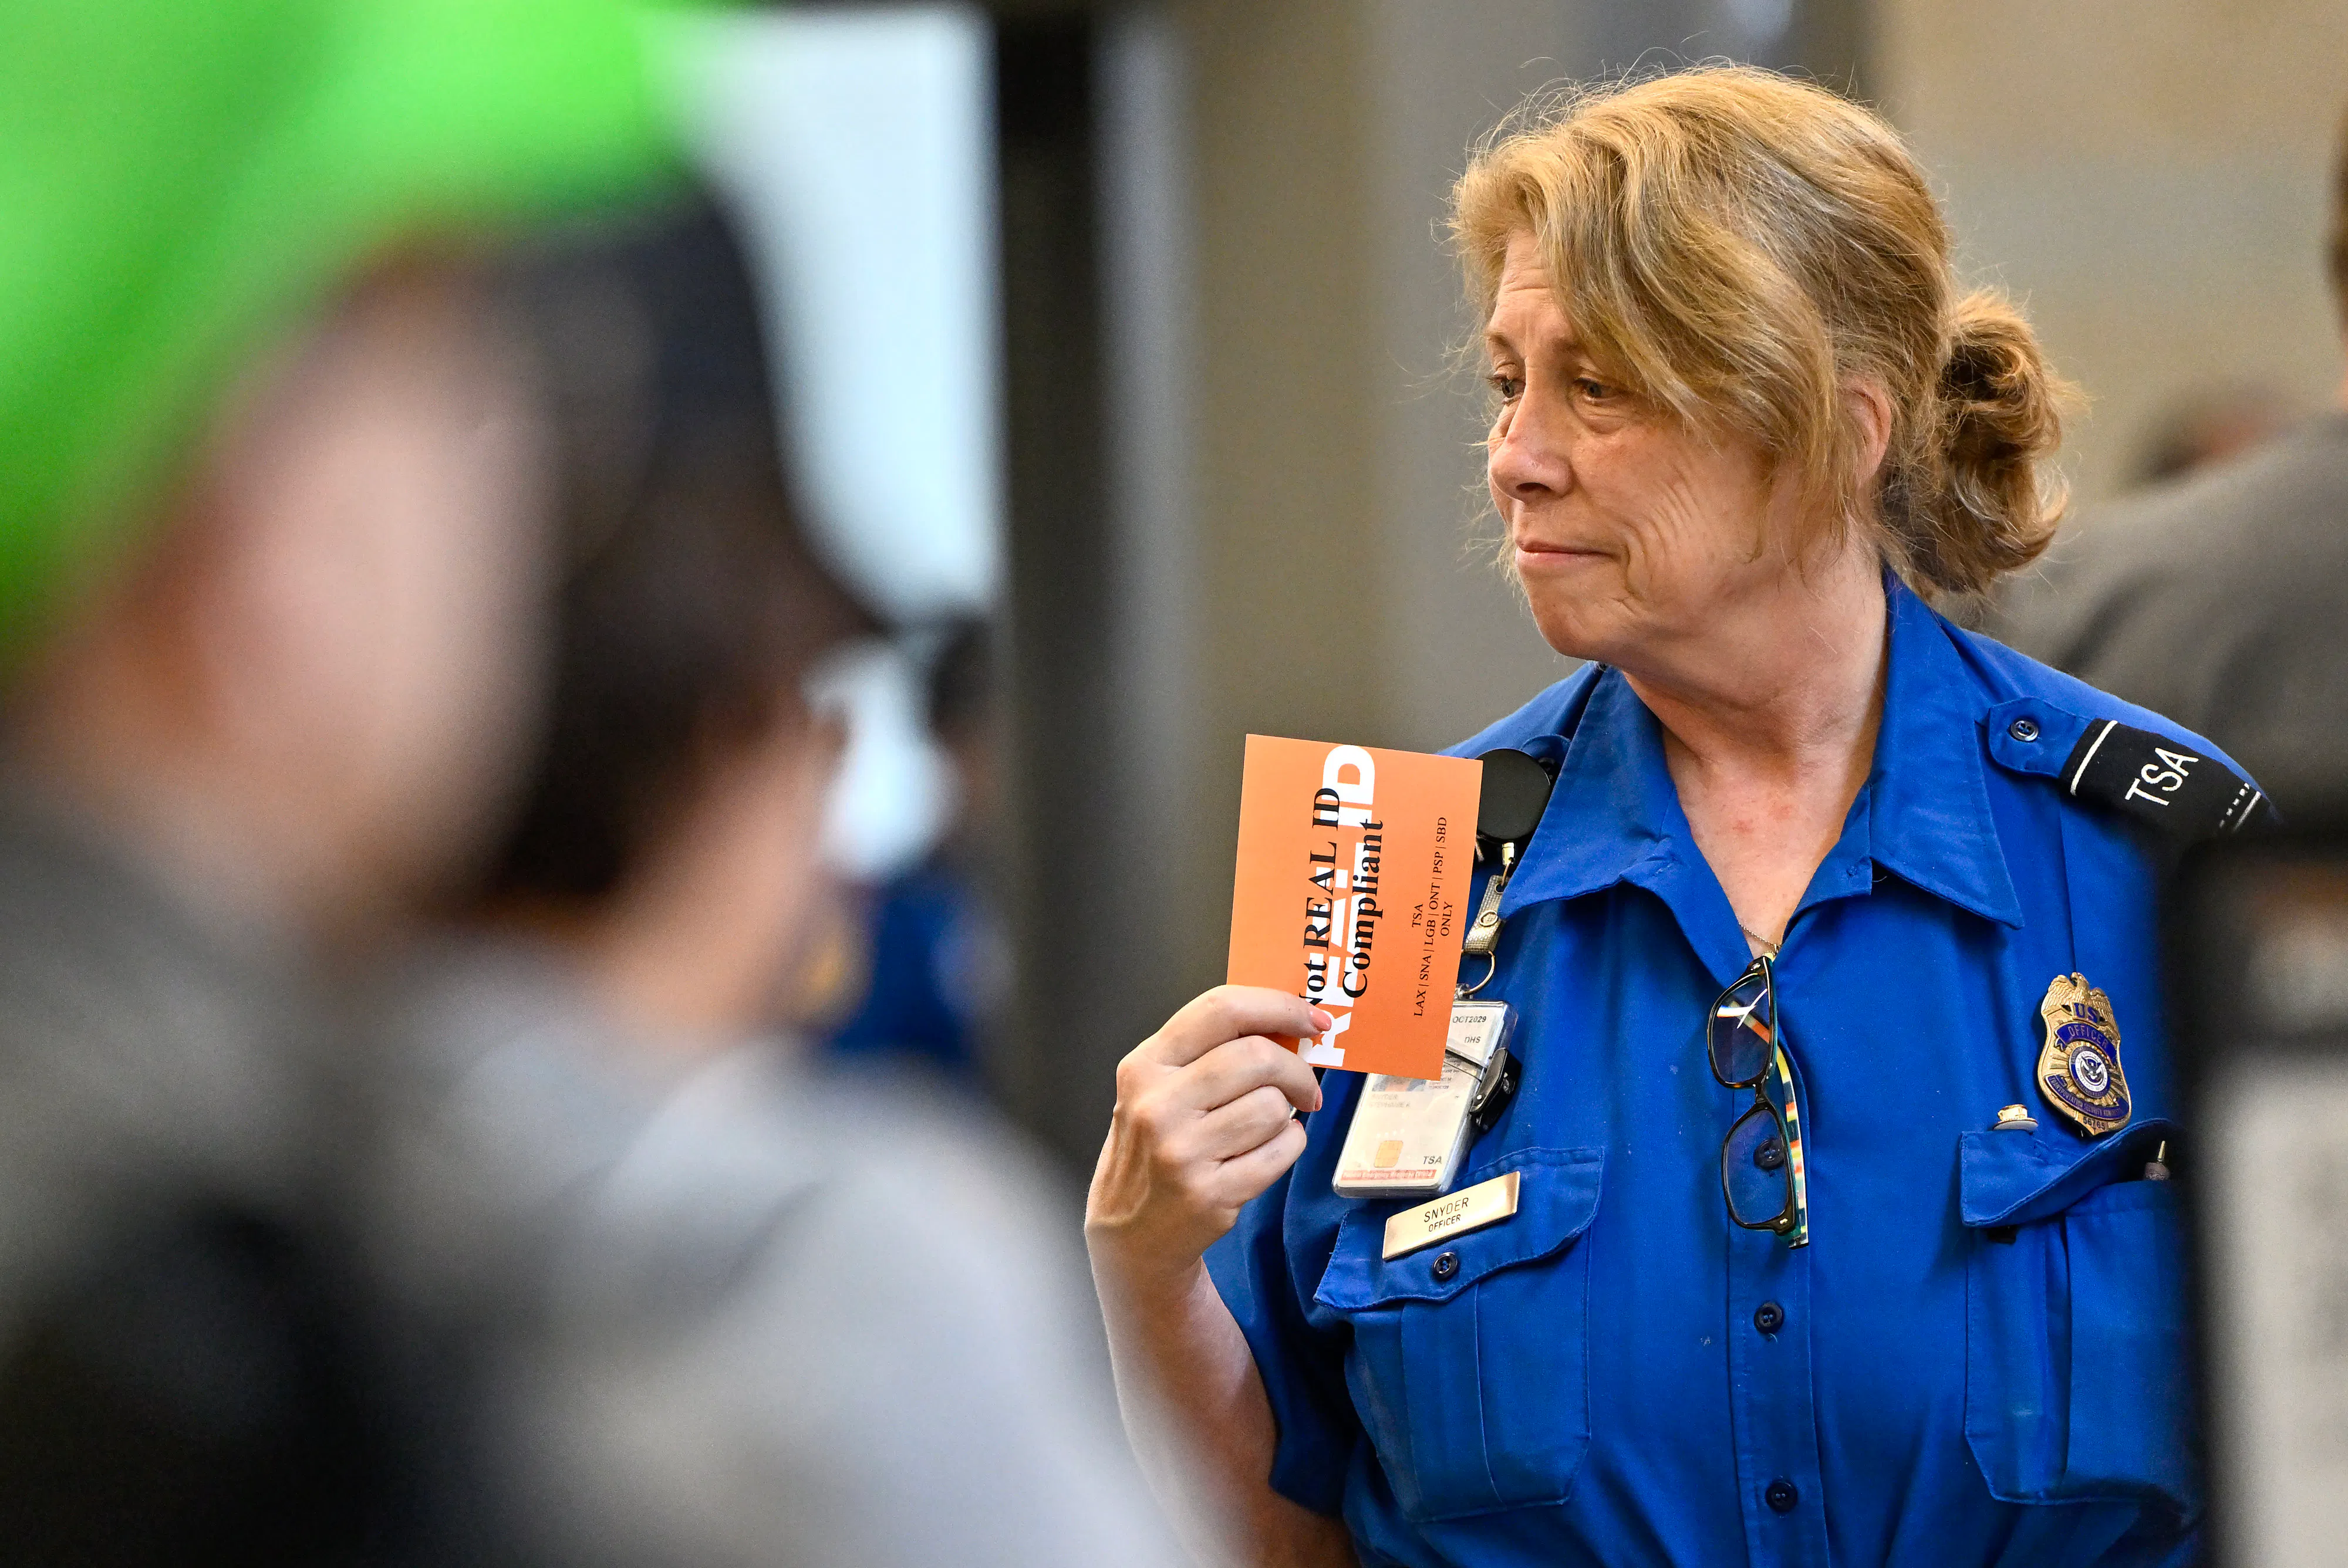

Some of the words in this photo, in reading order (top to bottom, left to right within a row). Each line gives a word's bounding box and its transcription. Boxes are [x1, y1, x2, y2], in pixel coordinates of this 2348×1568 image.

[1320, 745, 1375, 828] ID
[2125, 748, 2198, 806] TSA
[1312, 788, 1340, 831] ID
[1436, 817, 1447, 843] SBD
[1433, 851, 1443, 874] PSP
[1303, 841, 1337, 951] REAL
[1342, 819, 1383, 998] Compliant
[1429, 882, 1440, 910] ONT
[1412, 903, 1423, 928] TSA
[1440, 901, 1453, 937] ONLY
[1424, 919, 1436, 945] LGB
[1419, 955, 1432, 981] SNA
[1413, 989, 1426, 1016] LAX
[1452, 1015, 1487, 1023] OCT2029
[1464, 1036, 1482, 1044] DHS
[2067, 1024, 2109, 1049] OFFICER
[2083, 1116, 2106, 1130] 56765
[1423, 1155, 1443, 1164] TSA
[1424, 1197, 1469, 1222] SNYDER
[1429, 1214, 1460, 1232] OFFICER
